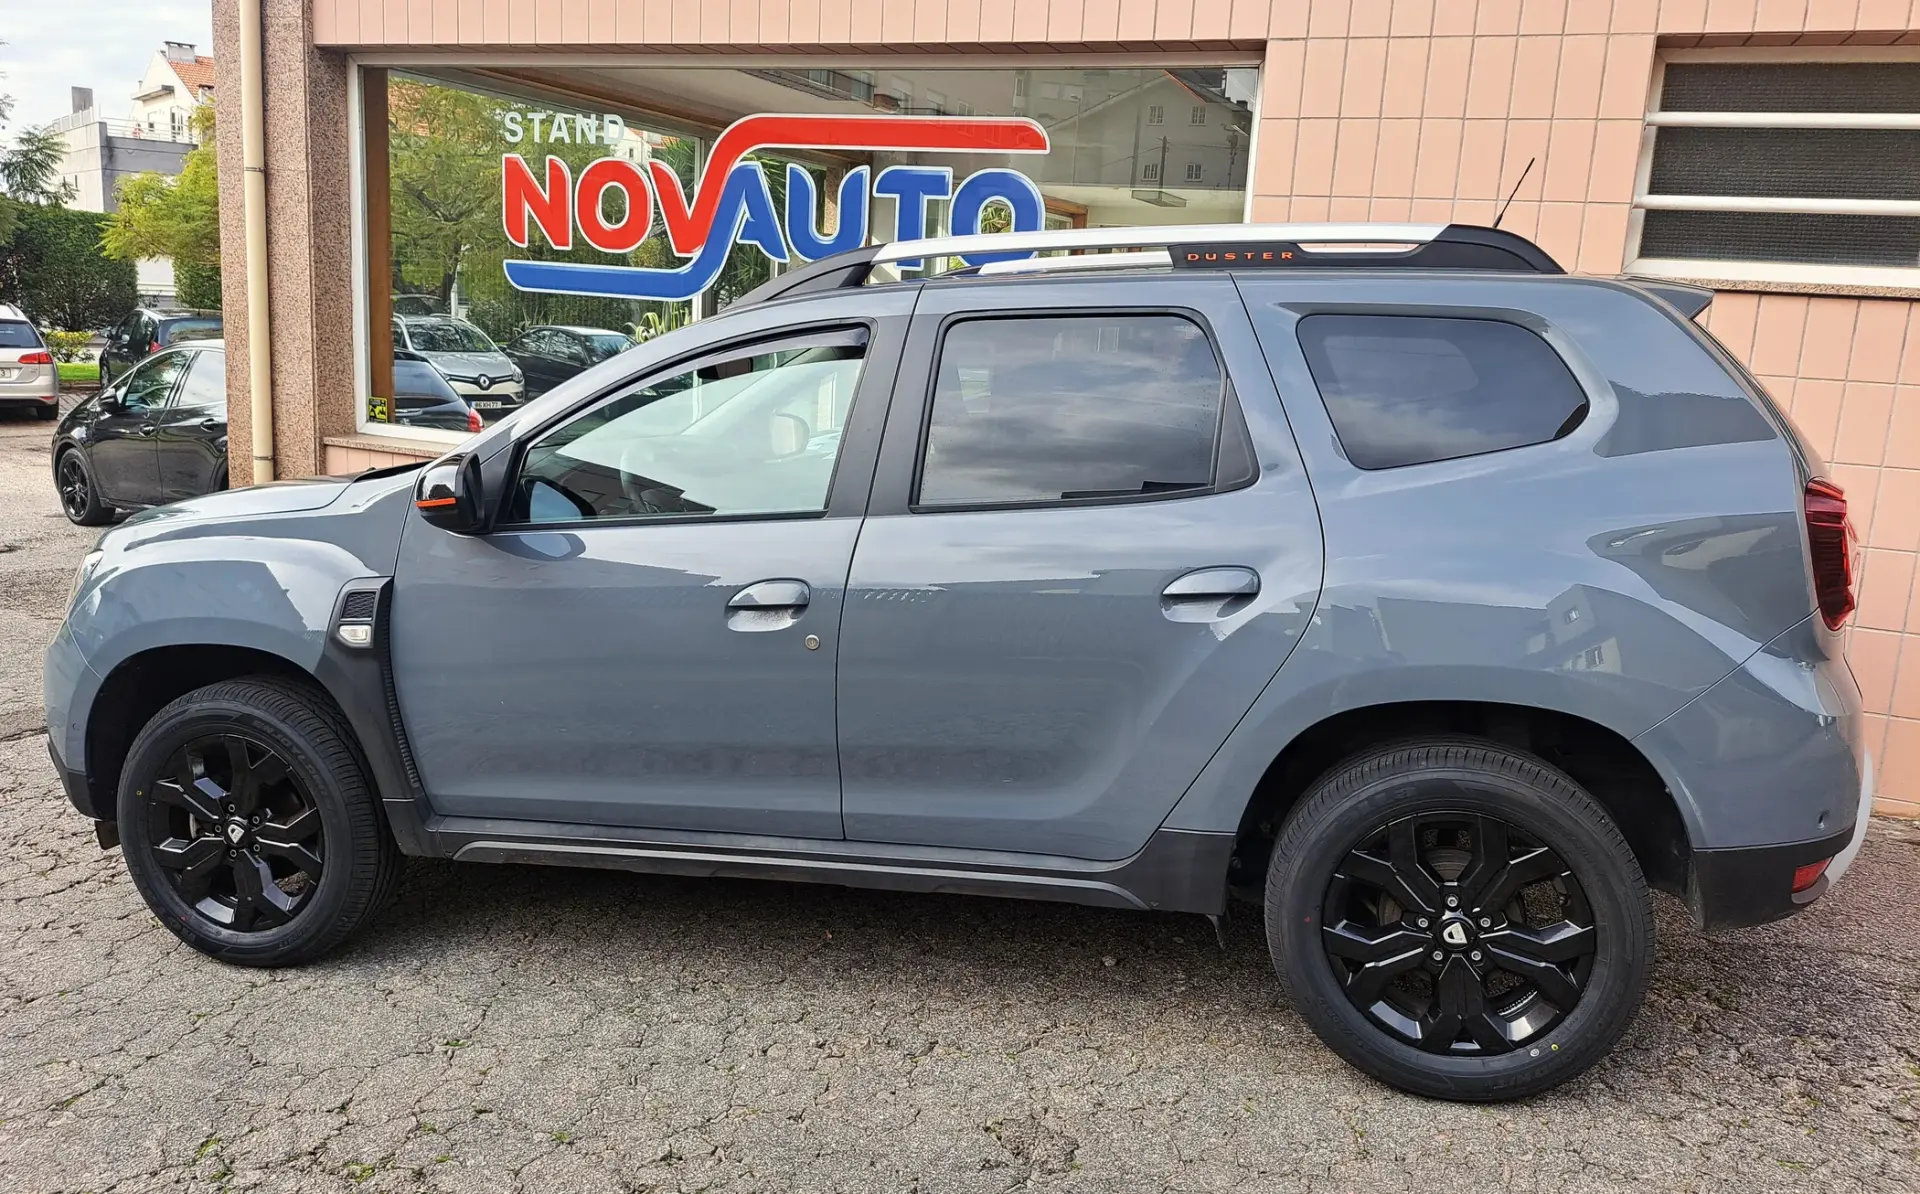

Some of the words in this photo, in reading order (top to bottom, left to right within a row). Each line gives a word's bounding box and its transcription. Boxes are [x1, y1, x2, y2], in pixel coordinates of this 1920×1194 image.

[503, 111, 625, 144] STAND
[502, 142, 1046, 275] NOVAUTO
[1188, 252, 1293, 261] DUSTER
